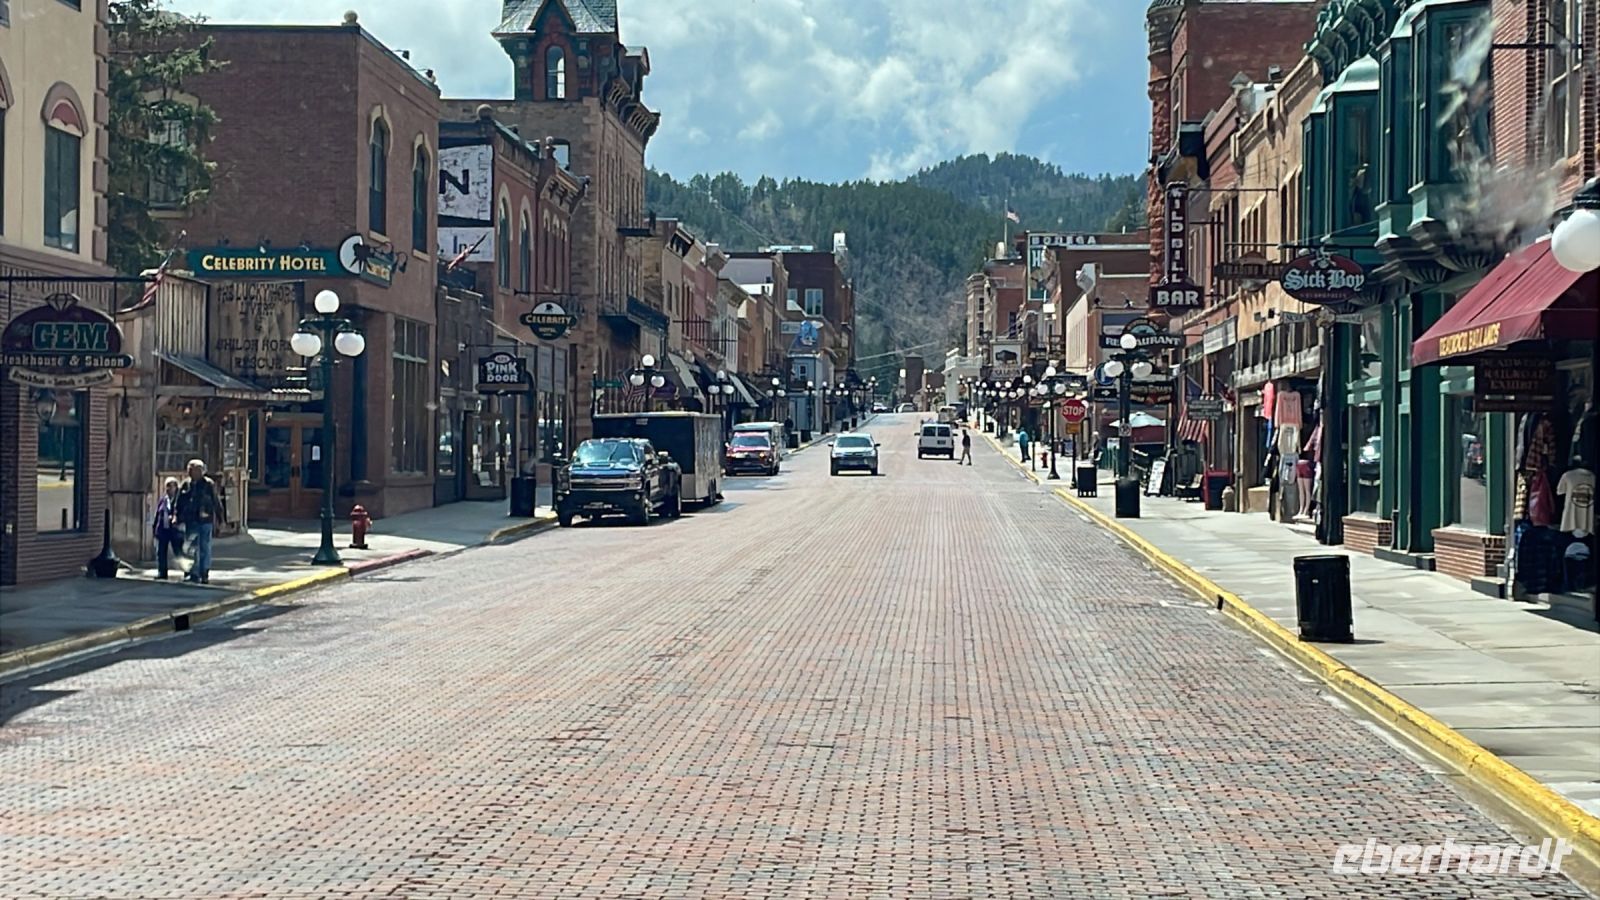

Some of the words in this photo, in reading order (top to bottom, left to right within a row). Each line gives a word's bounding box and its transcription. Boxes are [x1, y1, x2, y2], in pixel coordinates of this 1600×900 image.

[202, 254, 276, 271] CELEBRITY
[280, 255, 326, 270] HOTEL
[1283, 268, 1326, 290] Sick
[1327, 269, 1365, 292] Boy
[1157, 291, 1199, 305] BAR
[526, 314, 572, 324] CELEBRITY
[33, 322, 109, 351] GEM
[1105, 336, 1181, 347] REAURANT
[69, 354, 80, 366] &
[85, 355, 124, 367] Saloon
[485, 362, 518, 374] PINK
[486, 374, 519, 383] DOOR
[1063, 405, 1086, 416] STOP
